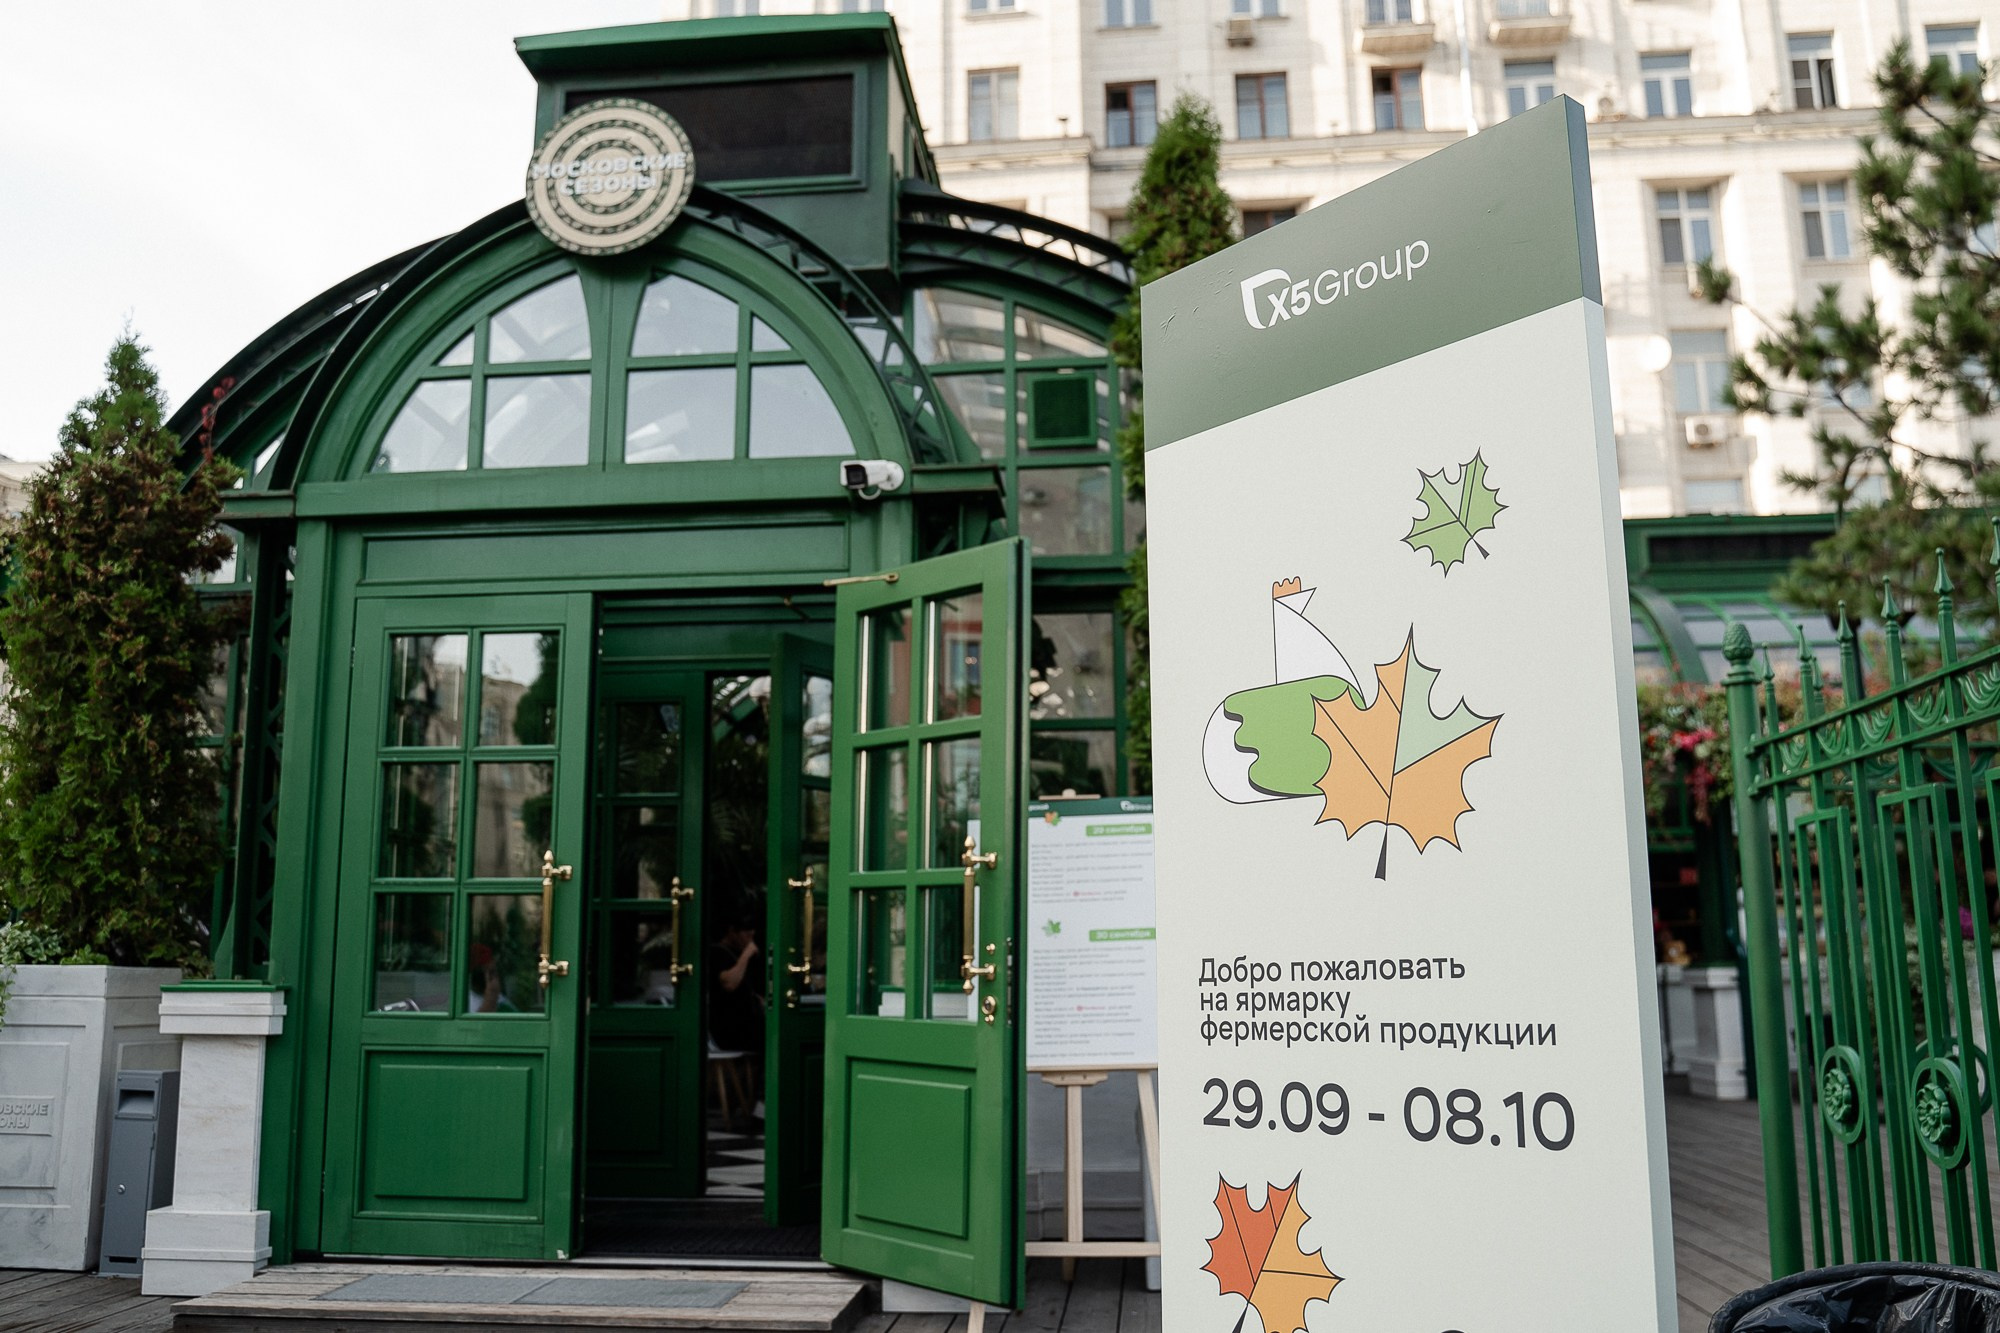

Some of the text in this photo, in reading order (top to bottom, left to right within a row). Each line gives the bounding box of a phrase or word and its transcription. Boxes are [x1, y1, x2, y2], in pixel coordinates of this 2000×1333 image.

[531, 151, 687, 179] МОСКОВСКИЕ
[560, 174, 656, 196] СЕЗОНЫ
[1199, 955, 1466, 988] Добро пожаловать
[1200, 990, 1351, 1018] на ярмарку
[1200, 1014, 1558, 1052] фермерской продукции
[1202, 1077, 1576, 1152] 29.09 - 08.10
